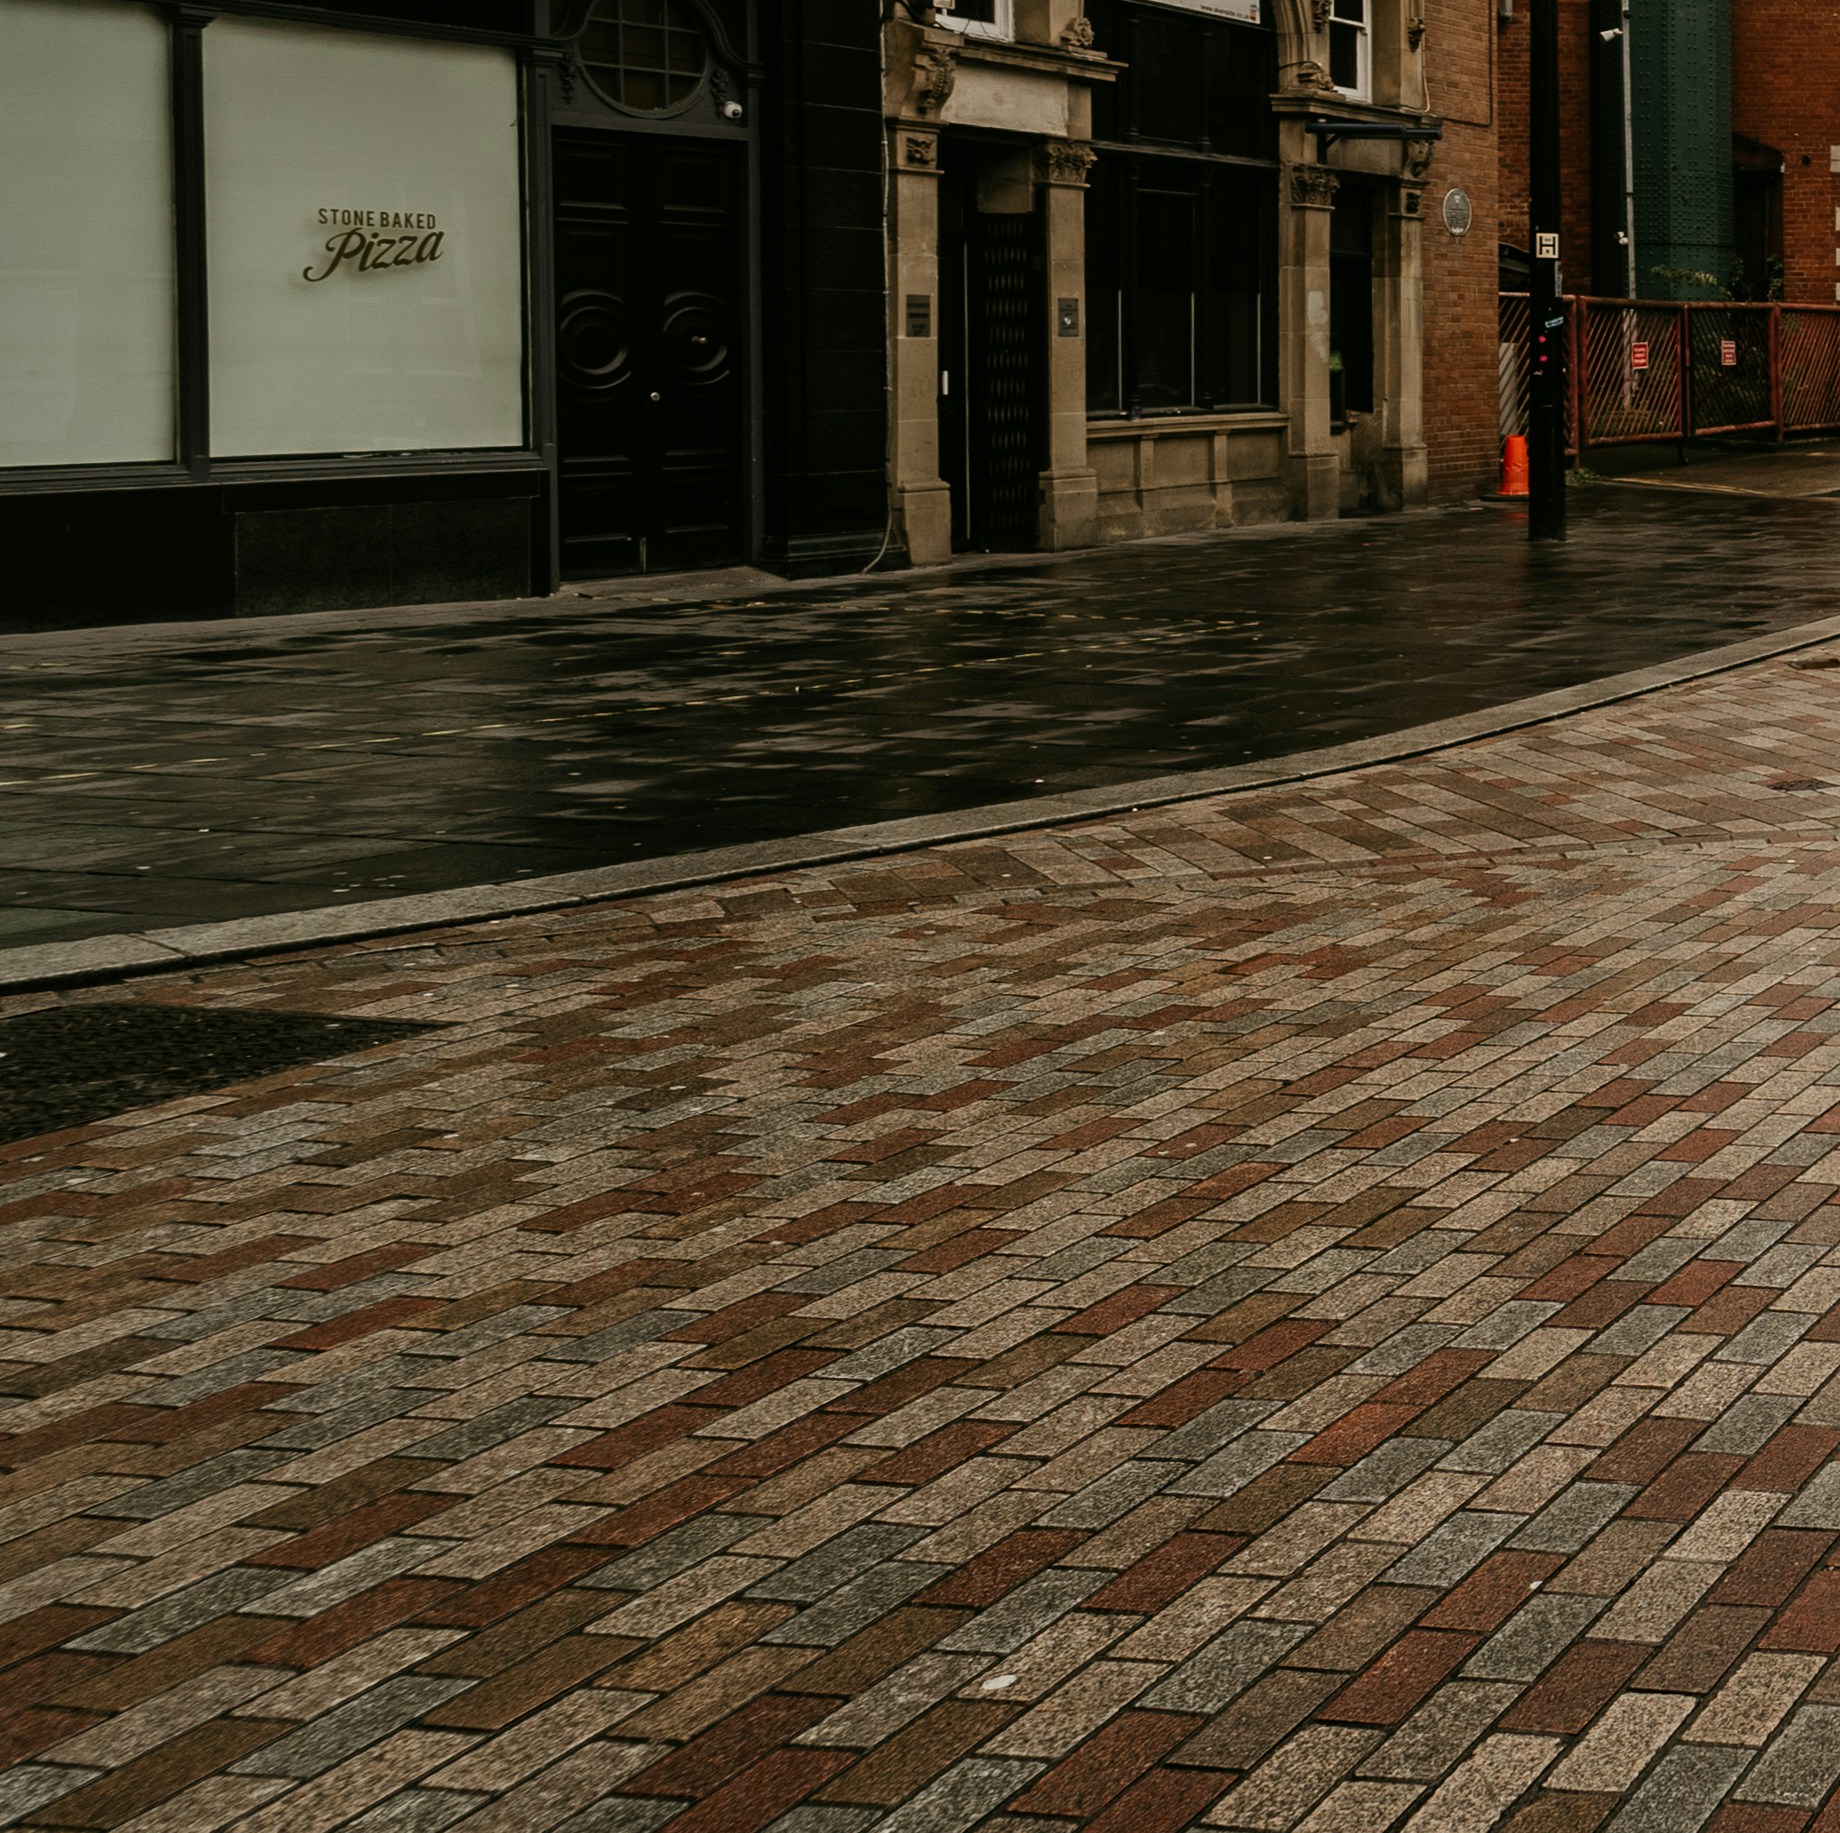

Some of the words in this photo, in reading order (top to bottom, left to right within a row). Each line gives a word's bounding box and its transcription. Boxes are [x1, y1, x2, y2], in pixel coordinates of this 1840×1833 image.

[318, 208, 375, 227] STONE
[380, 211, 436, 230] BAKED
[303, 227, 444, 282] Pizza
